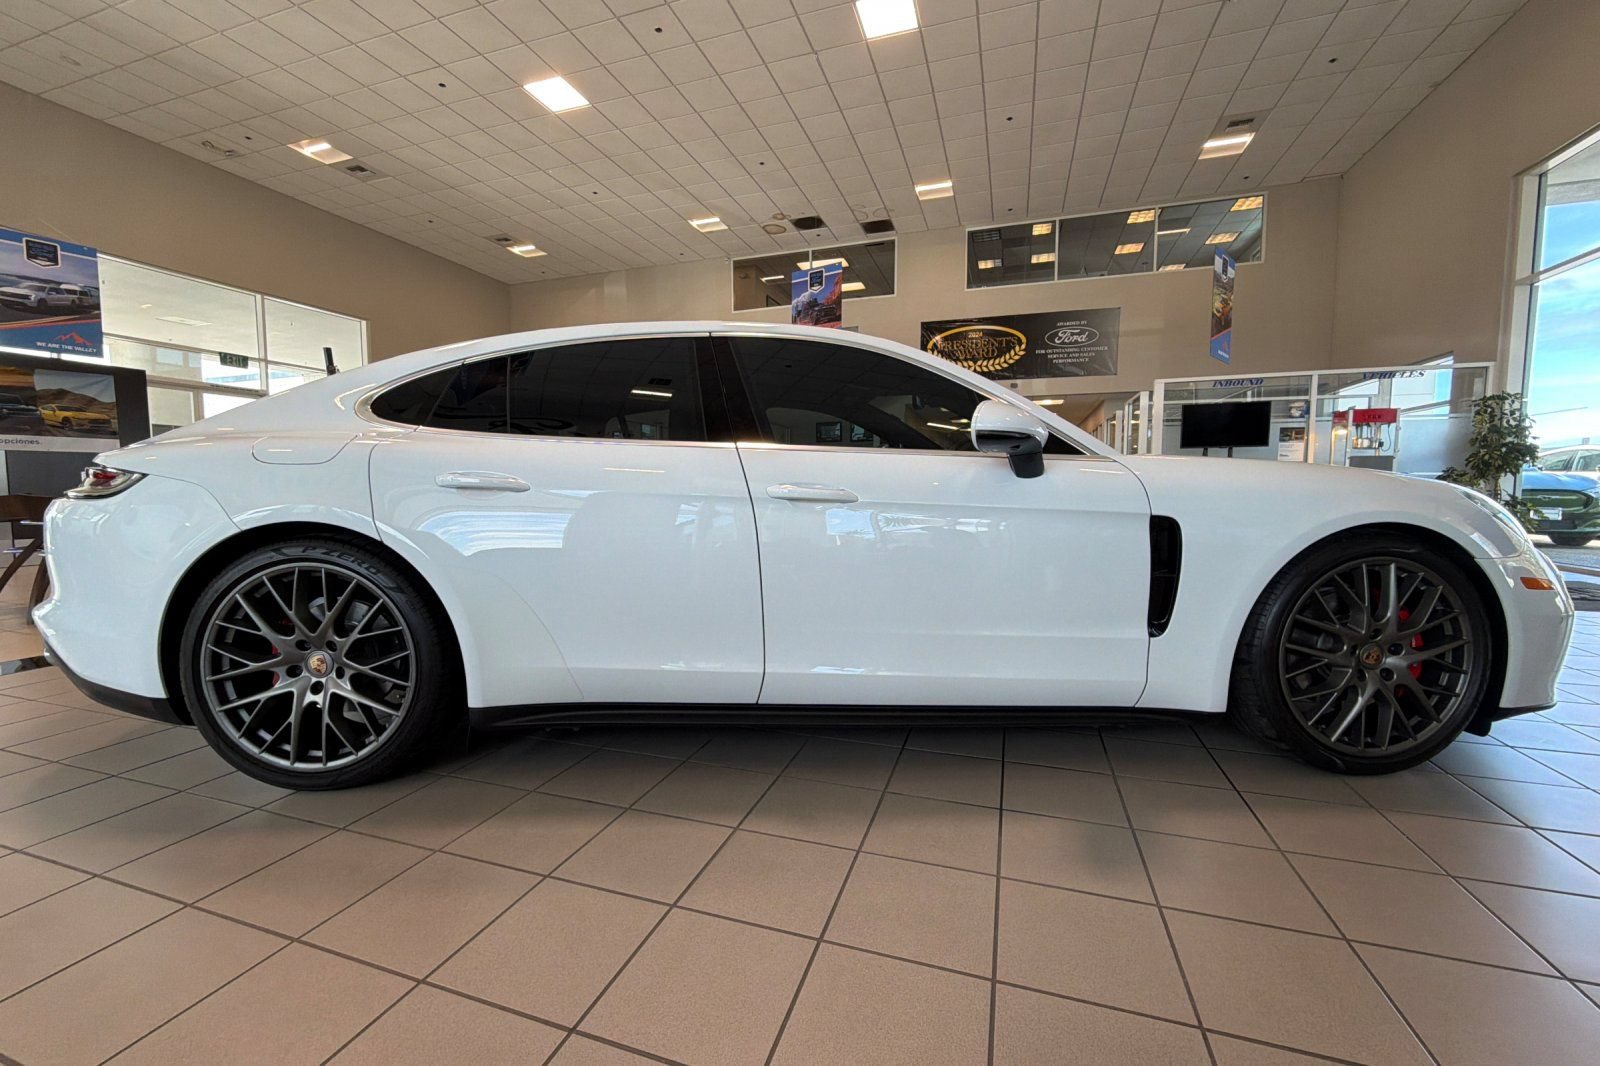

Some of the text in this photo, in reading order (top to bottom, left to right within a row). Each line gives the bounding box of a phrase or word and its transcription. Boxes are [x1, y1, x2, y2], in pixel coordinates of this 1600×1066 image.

[1054, 329, 1089, 343] Ford
[74, 345, 97, 353] VALLEY
[226, 355, 244, 368] EXIT
[1361, 369, 1426, 379] VEHICLES
[1212, 377, 1264, 388] INBOUND
